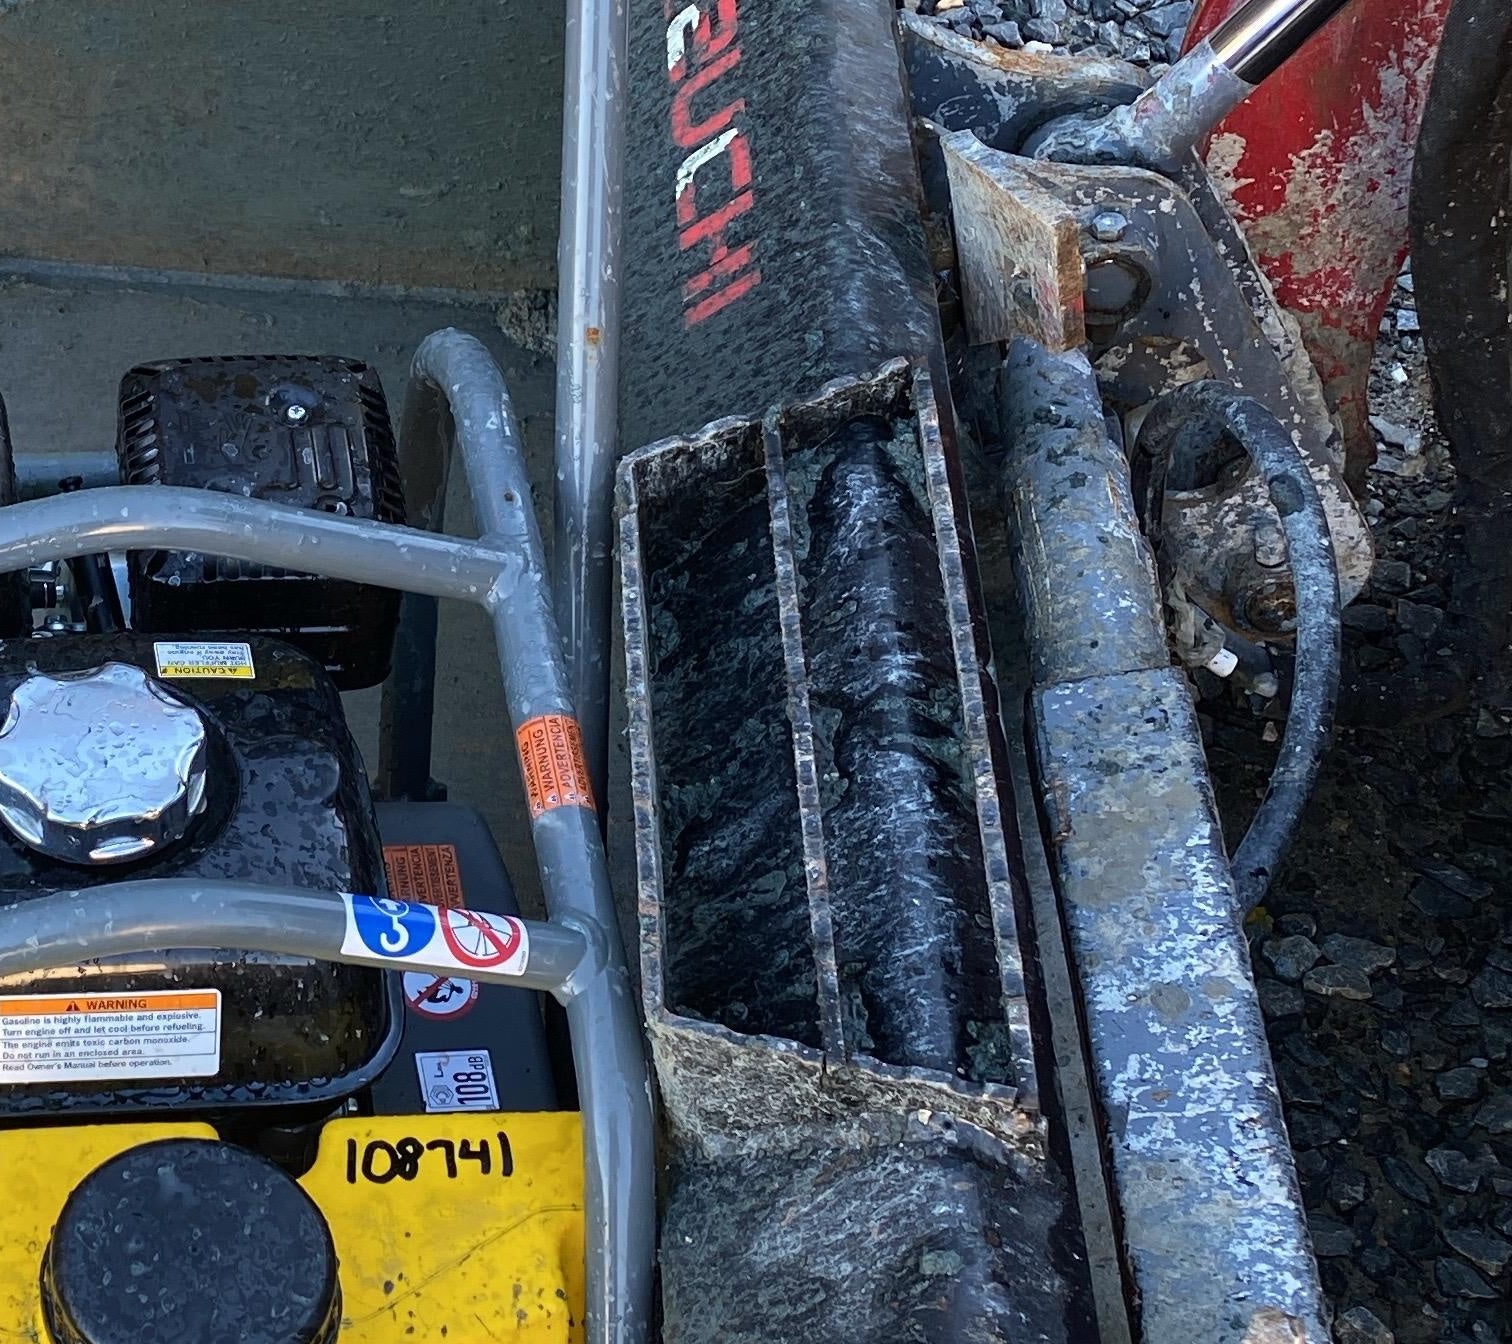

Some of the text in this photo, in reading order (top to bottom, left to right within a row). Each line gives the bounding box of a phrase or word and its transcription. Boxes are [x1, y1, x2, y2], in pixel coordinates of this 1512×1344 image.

[548, 717, 571, 789] ADVERTENCIA
[533, 728, 555, 793] WARNUNG
[410, 847, 428, 903] VERTENCIA
[86, 999, 147, 1010] WARNING
[1, 1011, 202, 1025] Gasoline is highly flammable and explosive.
[2, 1028, 22, 1036] Turn
[25, 1027, 56, 1036] engine
[58, 1026, 72, 1034] off
[74, 1026, 91, 1034] and
[108, 1024, 128, 1033] cool
[130, 1024, 160, 1032] before
[162, 1023, 206, 1031] refueling.
[2, 1041, 19, 1049] The
[21, 1039, 53, 1049] engine
[55, 1039, 81, 1047] emits
[108, 1037, 141, 1045] carbon
[143, 1036, 191, 1044] monoxide.
[2, 1051, 15, 1059] Do
[17, 1051, 32, 1059] not
[52, 1050, 62, 1058] in
[78, 1048, 119, 1057] enclosed
[2, 1063, 25, 1071] Read
[63, 1061, 96, 1069] Manual
[98, 1060, 127, 1068] before
[128, 1059, 173, 1068] operation.
[345, 1130, 515, 1185] 108741
